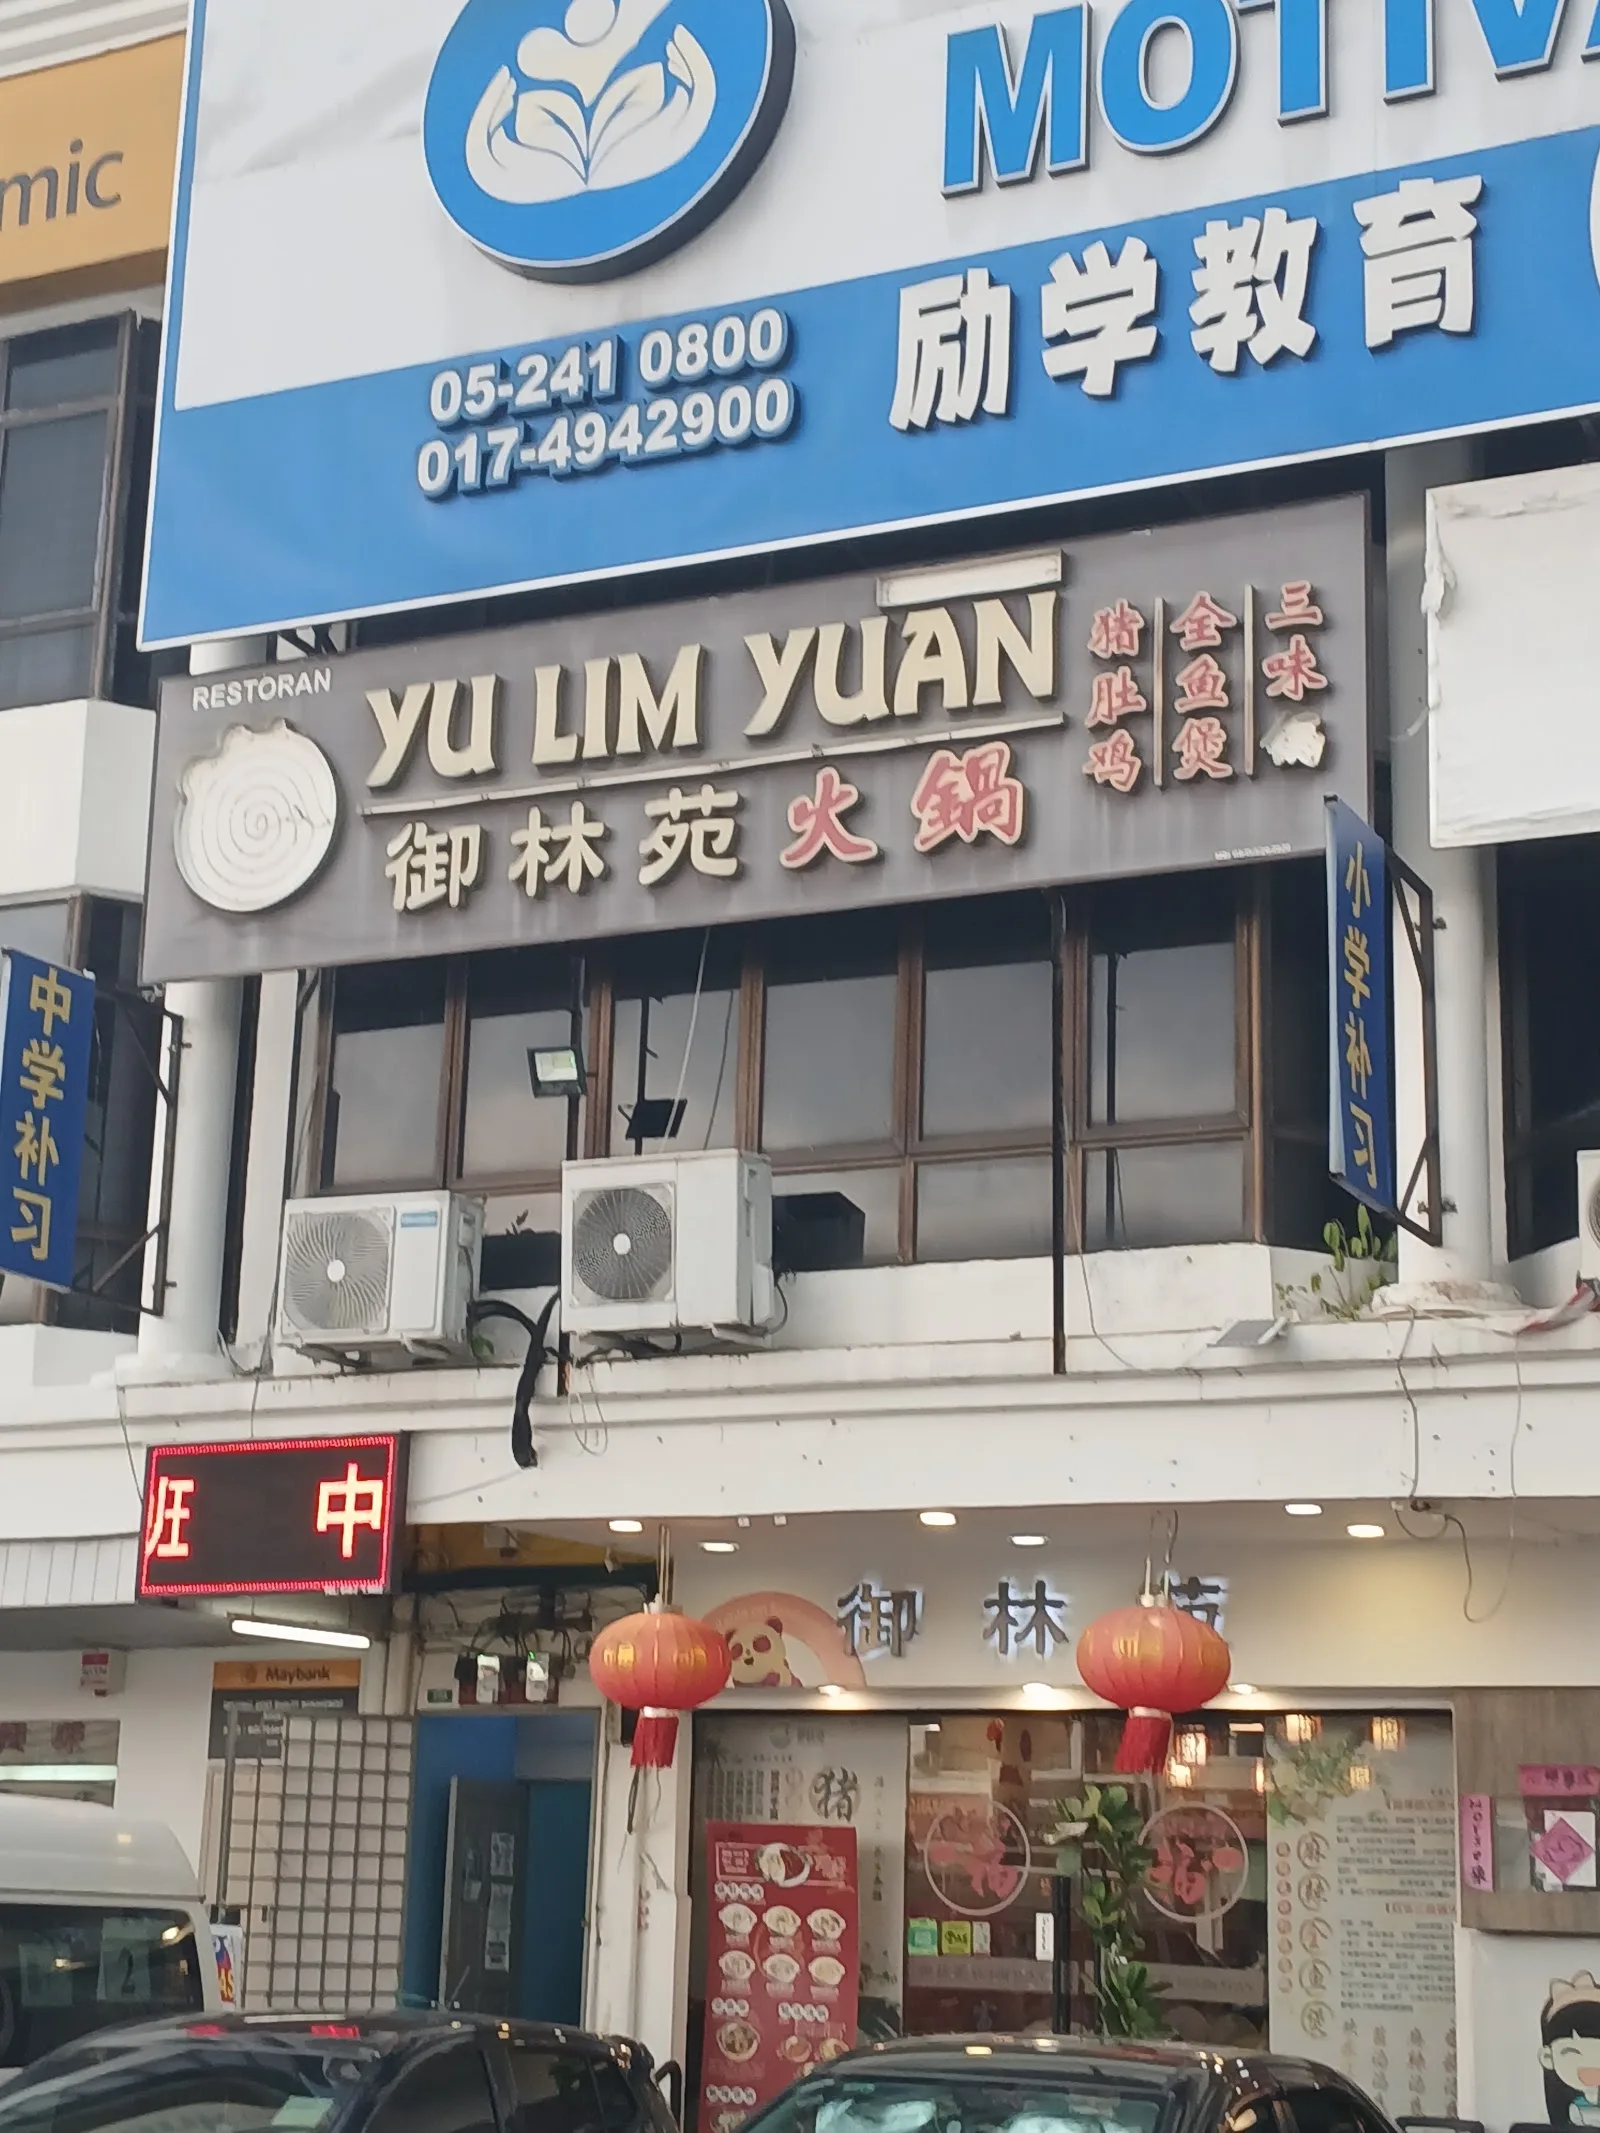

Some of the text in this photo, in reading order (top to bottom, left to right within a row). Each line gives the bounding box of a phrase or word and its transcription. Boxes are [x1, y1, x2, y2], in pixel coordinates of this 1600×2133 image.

[429, 307, 789, 426] 05-241 0800
[888, 174, 1485, 432] 励学教育
[416, 377, 798, 500] 017-4942900
[190, 668, 333, 711] RESTORAN
[365, 588, 1057, 788] YU LIM YUAN
[1082, 597, 1147, 793] 猪肚鸡
[1345, 841, 1378, 1190] 小学补习
[10, 967, 72, 1262] 中学补习
[265, 1664, 332, 1685] Maybank
